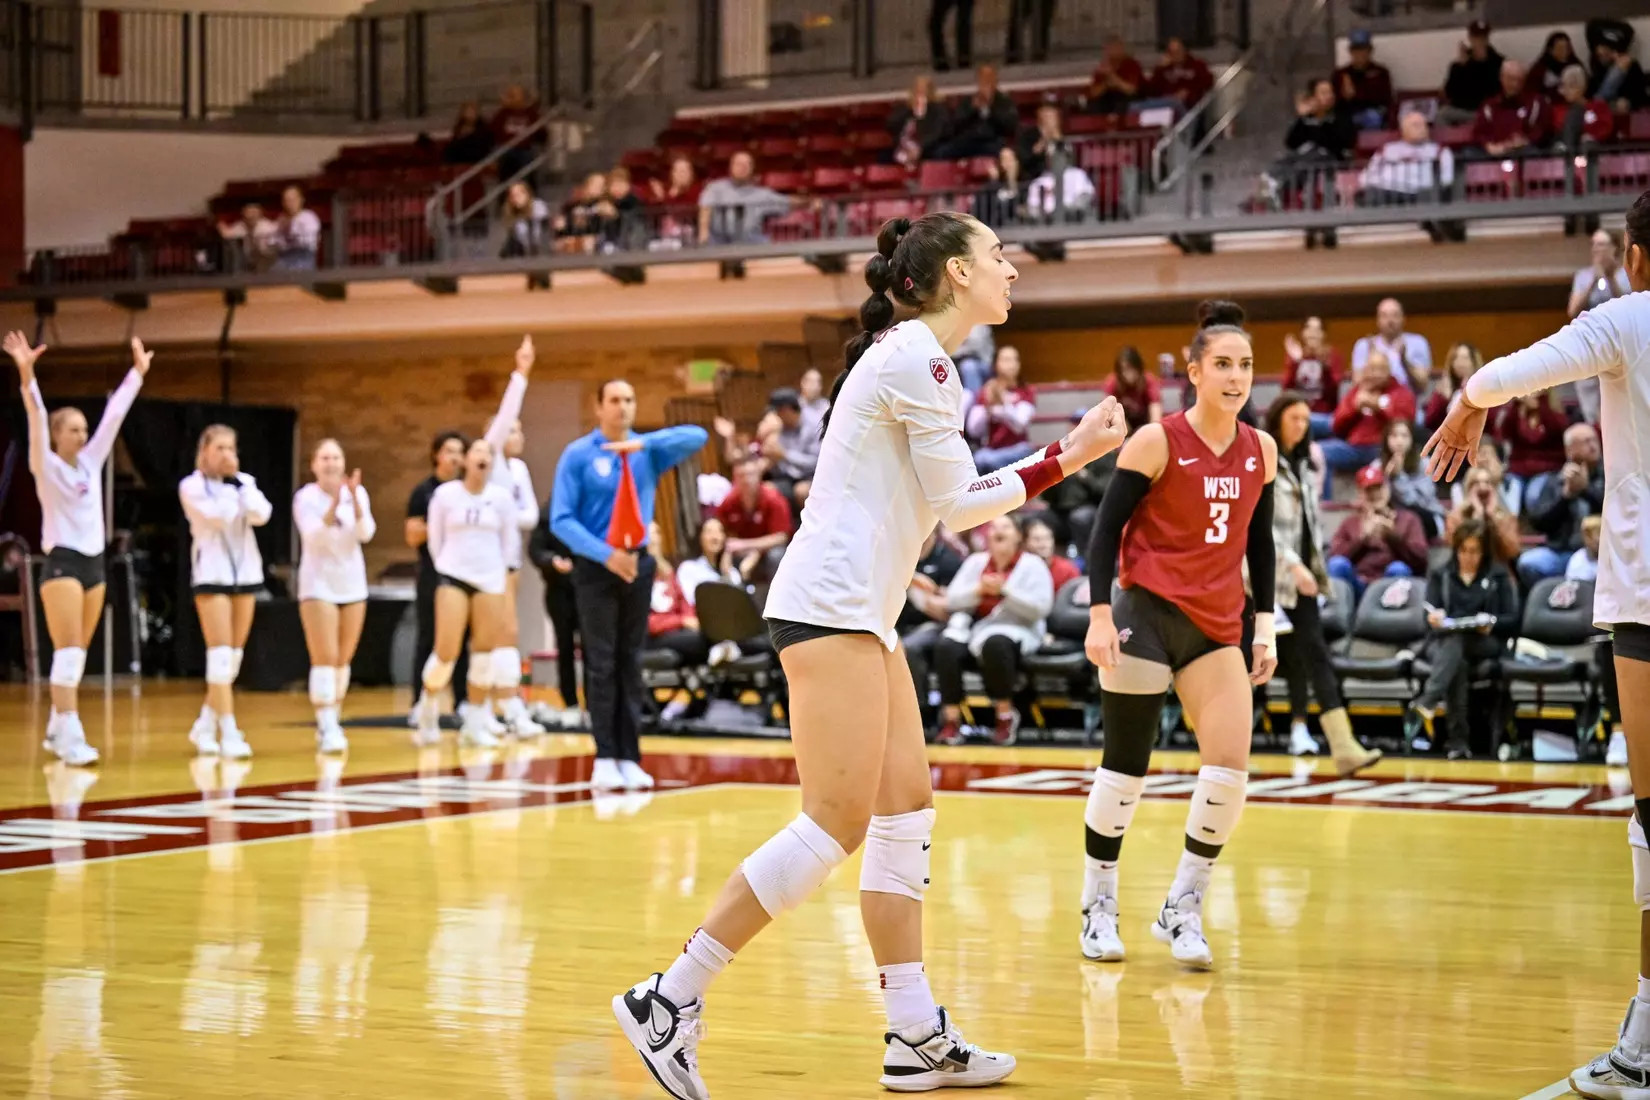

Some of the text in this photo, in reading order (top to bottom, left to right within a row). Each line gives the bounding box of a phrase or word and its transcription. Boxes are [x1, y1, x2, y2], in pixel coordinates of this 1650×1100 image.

[936, 371, 946, 380] 12
[1203, 476, 1240, 499] WSU
[1205, 502, 1230, 544] 3
